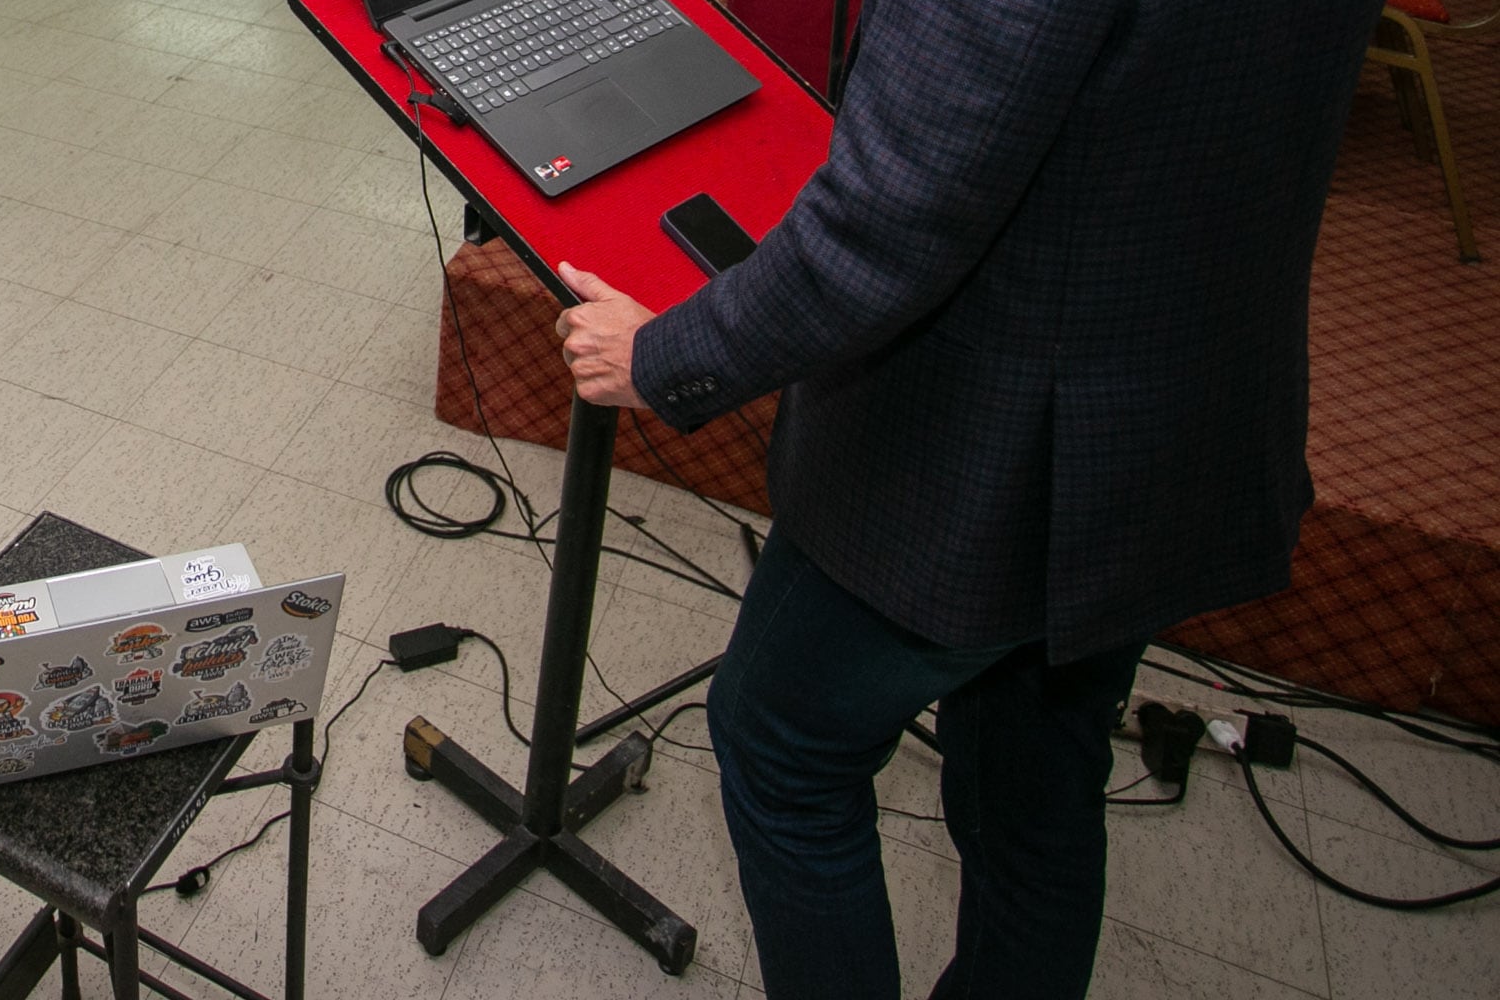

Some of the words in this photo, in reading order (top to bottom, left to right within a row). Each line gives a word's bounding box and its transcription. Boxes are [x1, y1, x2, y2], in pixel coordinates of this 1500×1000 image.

[186, 560, 202, 572] Up
[183, 565, 221, 585] Give
[287, 591, 330, 613] Stokle
[16, 612, 36, 623] YOU
[190, 614, 220, 627] aws
[195, 635, 250, 658] cloud
